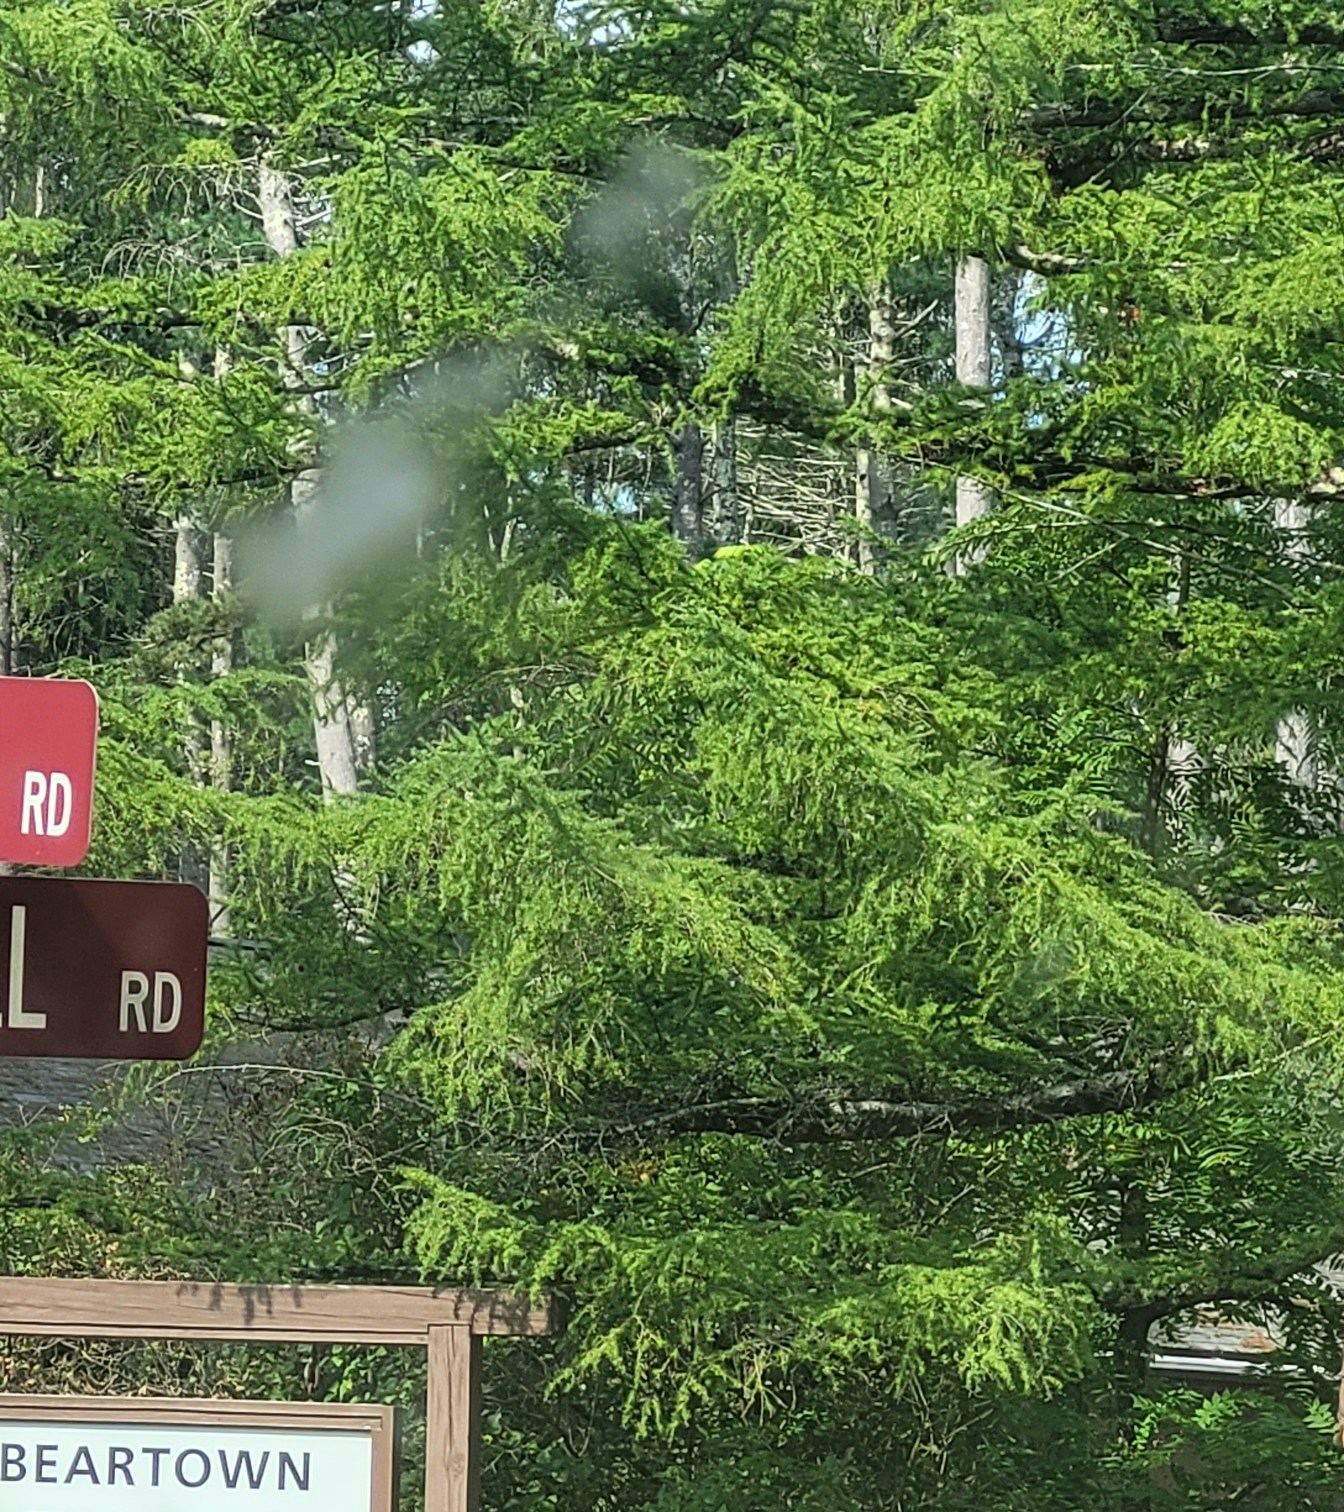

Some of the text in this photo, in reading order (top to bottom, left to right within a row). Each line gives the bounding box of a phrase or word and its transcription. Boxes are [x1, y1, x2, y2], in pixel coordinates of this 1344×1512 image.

[20, 769, 73, 837] RD
[118, 970, 183, 1034] RD
[0, 1442, 312, 1491] BEARTOWN
